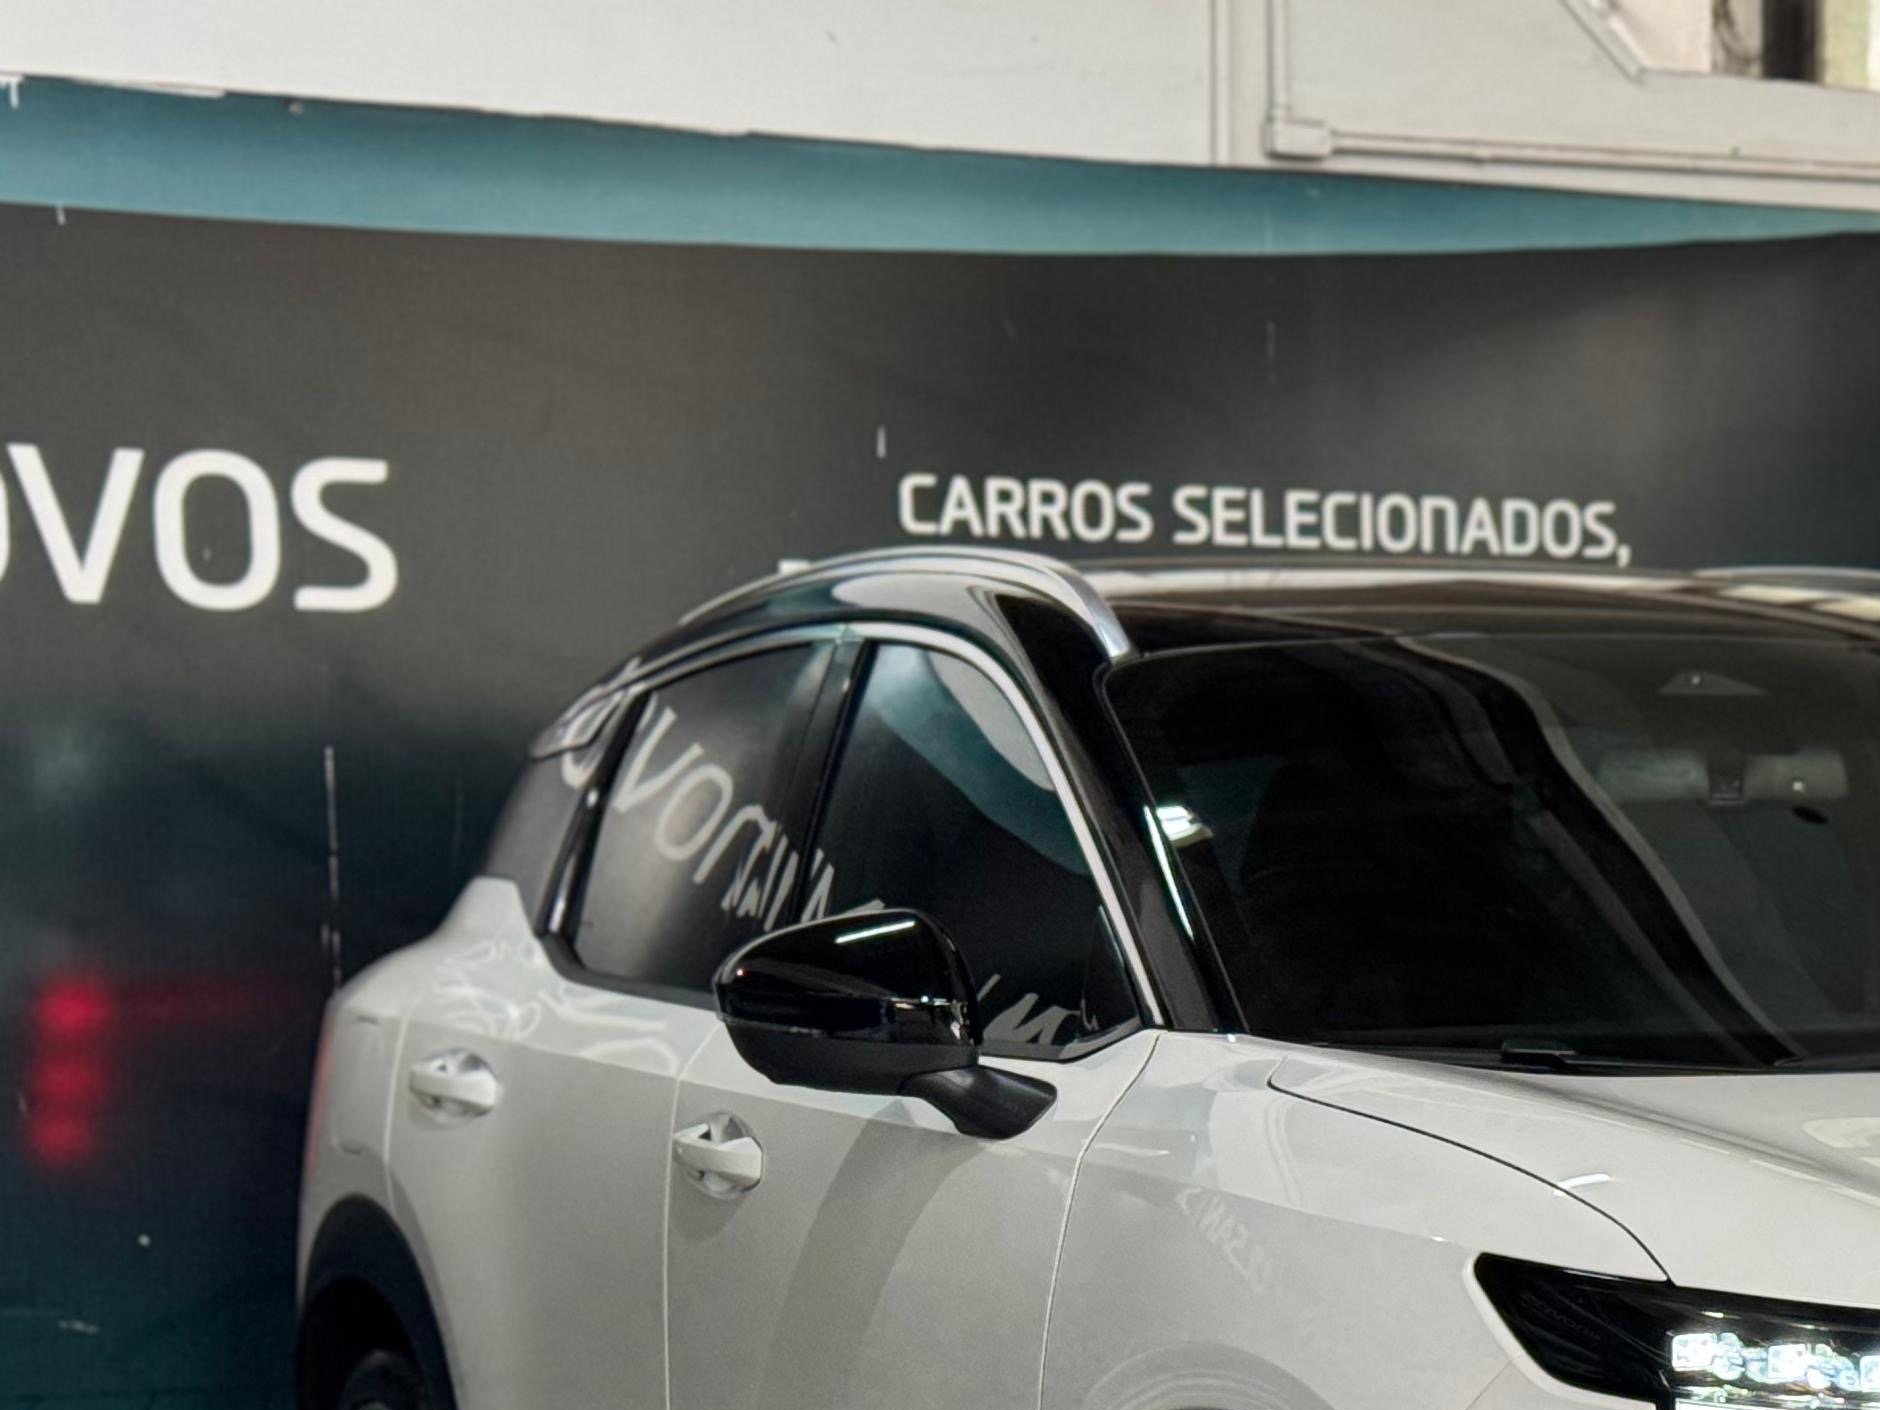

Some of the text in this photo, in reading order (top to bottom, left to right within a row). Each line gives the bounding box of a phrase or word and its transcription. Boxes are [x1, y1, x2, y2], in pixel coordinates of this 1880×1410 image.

[0, 442, 399, 614] VOS
[898, 472, 1632, 569] CARROS SELECIONADOS,
